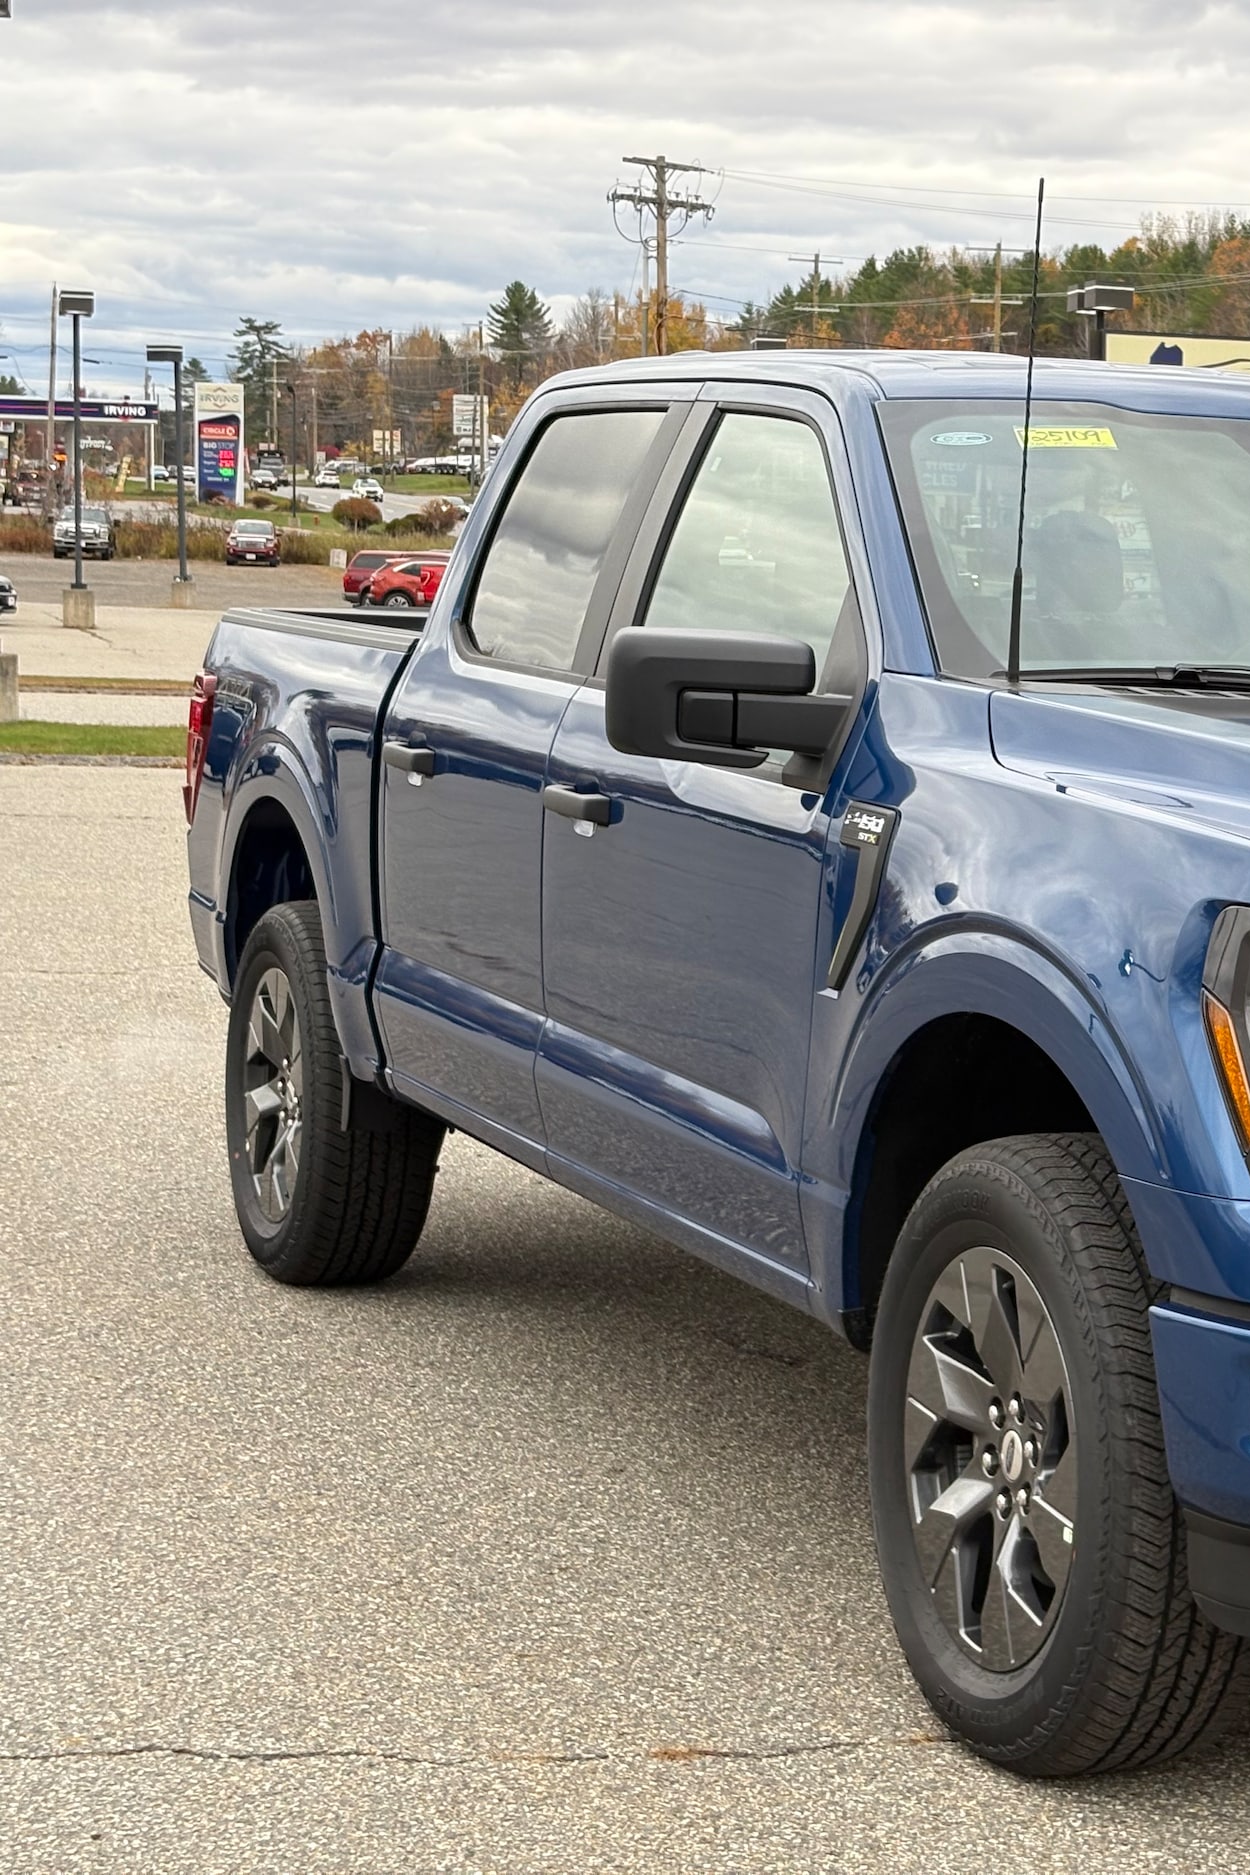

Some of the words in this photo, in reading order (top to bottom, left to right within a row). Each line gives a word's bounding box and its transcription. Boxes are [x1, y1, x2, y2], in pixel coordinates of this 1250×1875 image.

[200, 393, 239, 404] IRVING
[104, 405, 146, 417] IRVING
[858, 832, 876, 843] STX
